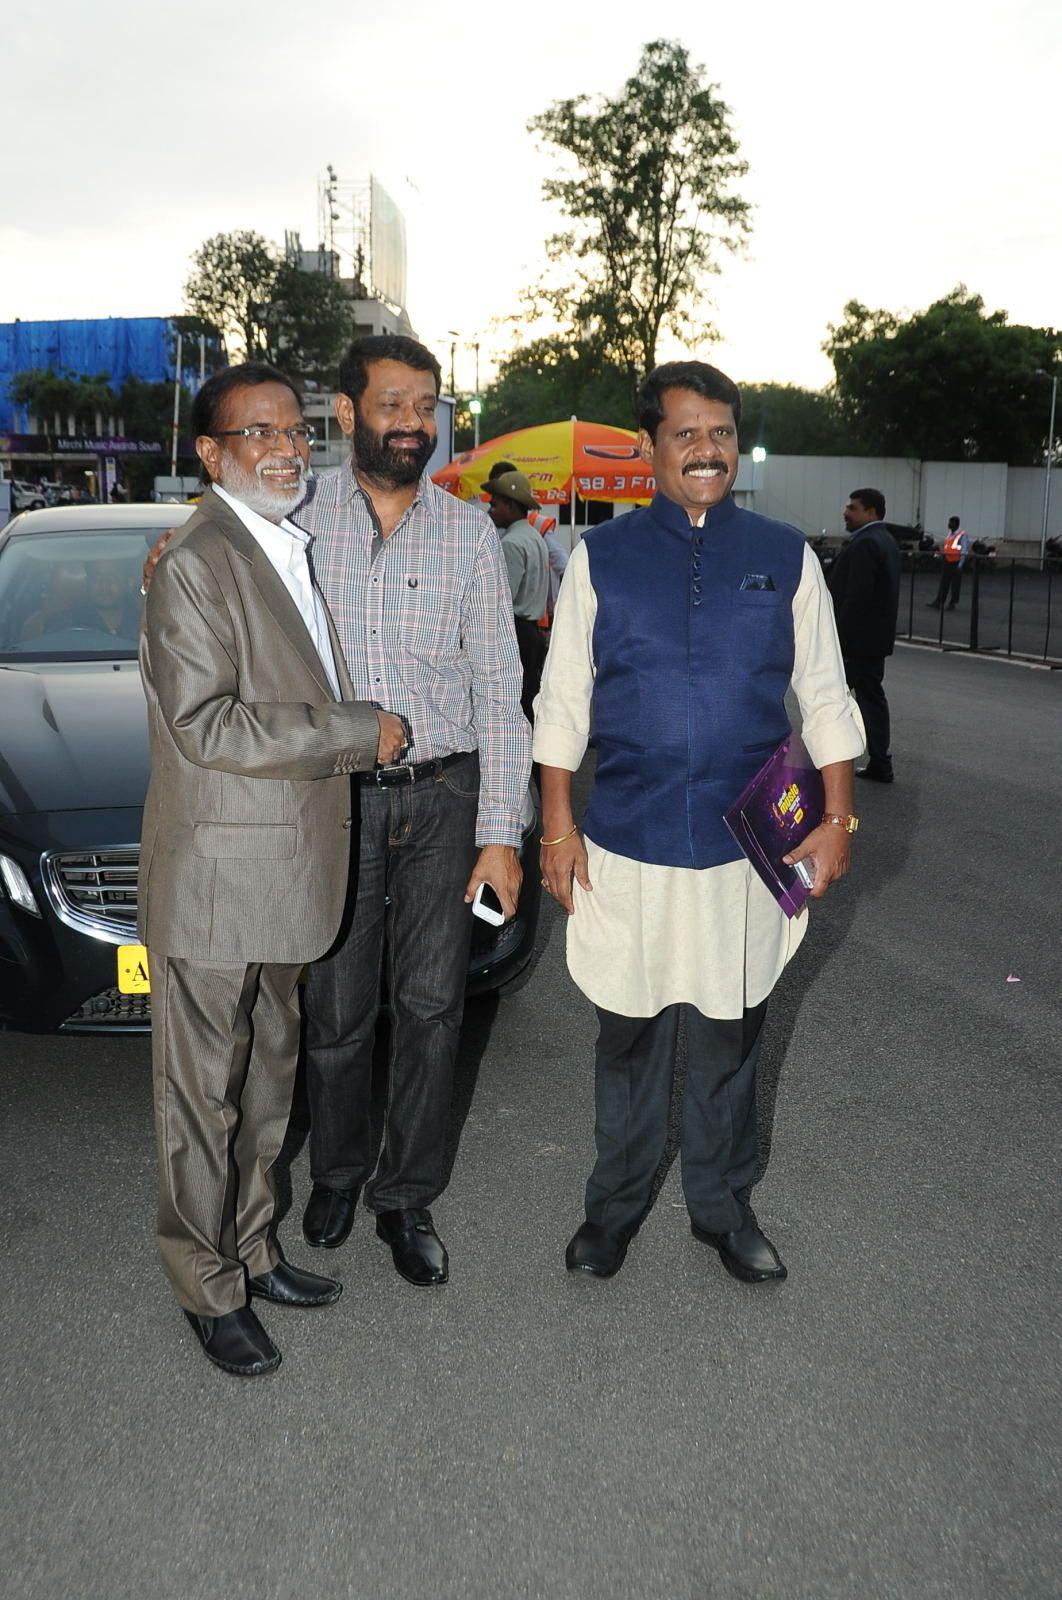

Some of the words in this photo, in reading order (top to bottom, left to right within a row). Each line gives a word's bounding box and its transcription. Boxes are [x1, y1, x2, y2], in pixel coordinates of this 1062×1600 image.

[57, 439, 82, 449] Mirchi
[84, 440, 108, 450] Music
[138, 441, 162, 452] South
[578, 476, 626, 490] 98.3
